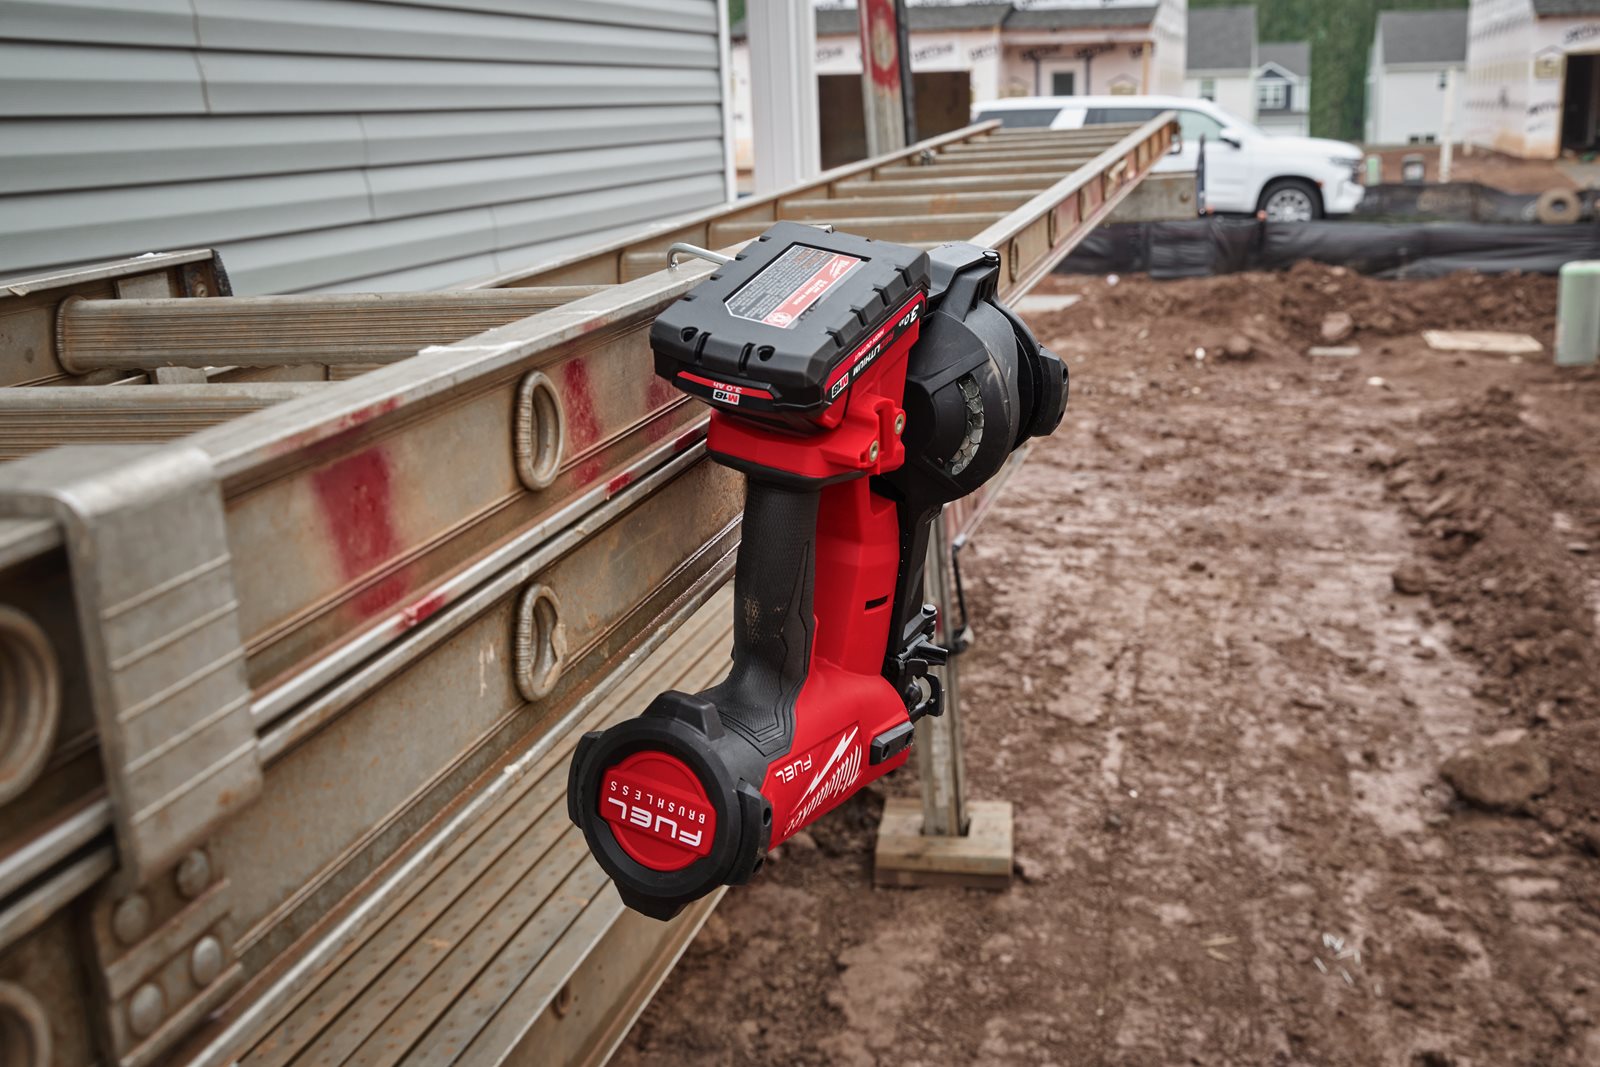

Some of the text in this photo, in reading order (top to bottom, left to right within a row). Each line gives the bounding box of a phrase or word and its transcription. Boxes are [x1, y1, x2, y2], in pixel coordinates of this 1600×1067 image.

[714, 391, 738, 404] M18
[726, 385, 742, 393] 3.0
[832, 374, 849, 397] M18
[775, 754, 812, 784] FUEL
[610, 780, 706, 824] BRUSHLESS
[784, 744, 863, 836] Milwaukee
[608, 797, 703, 847] FUEL
